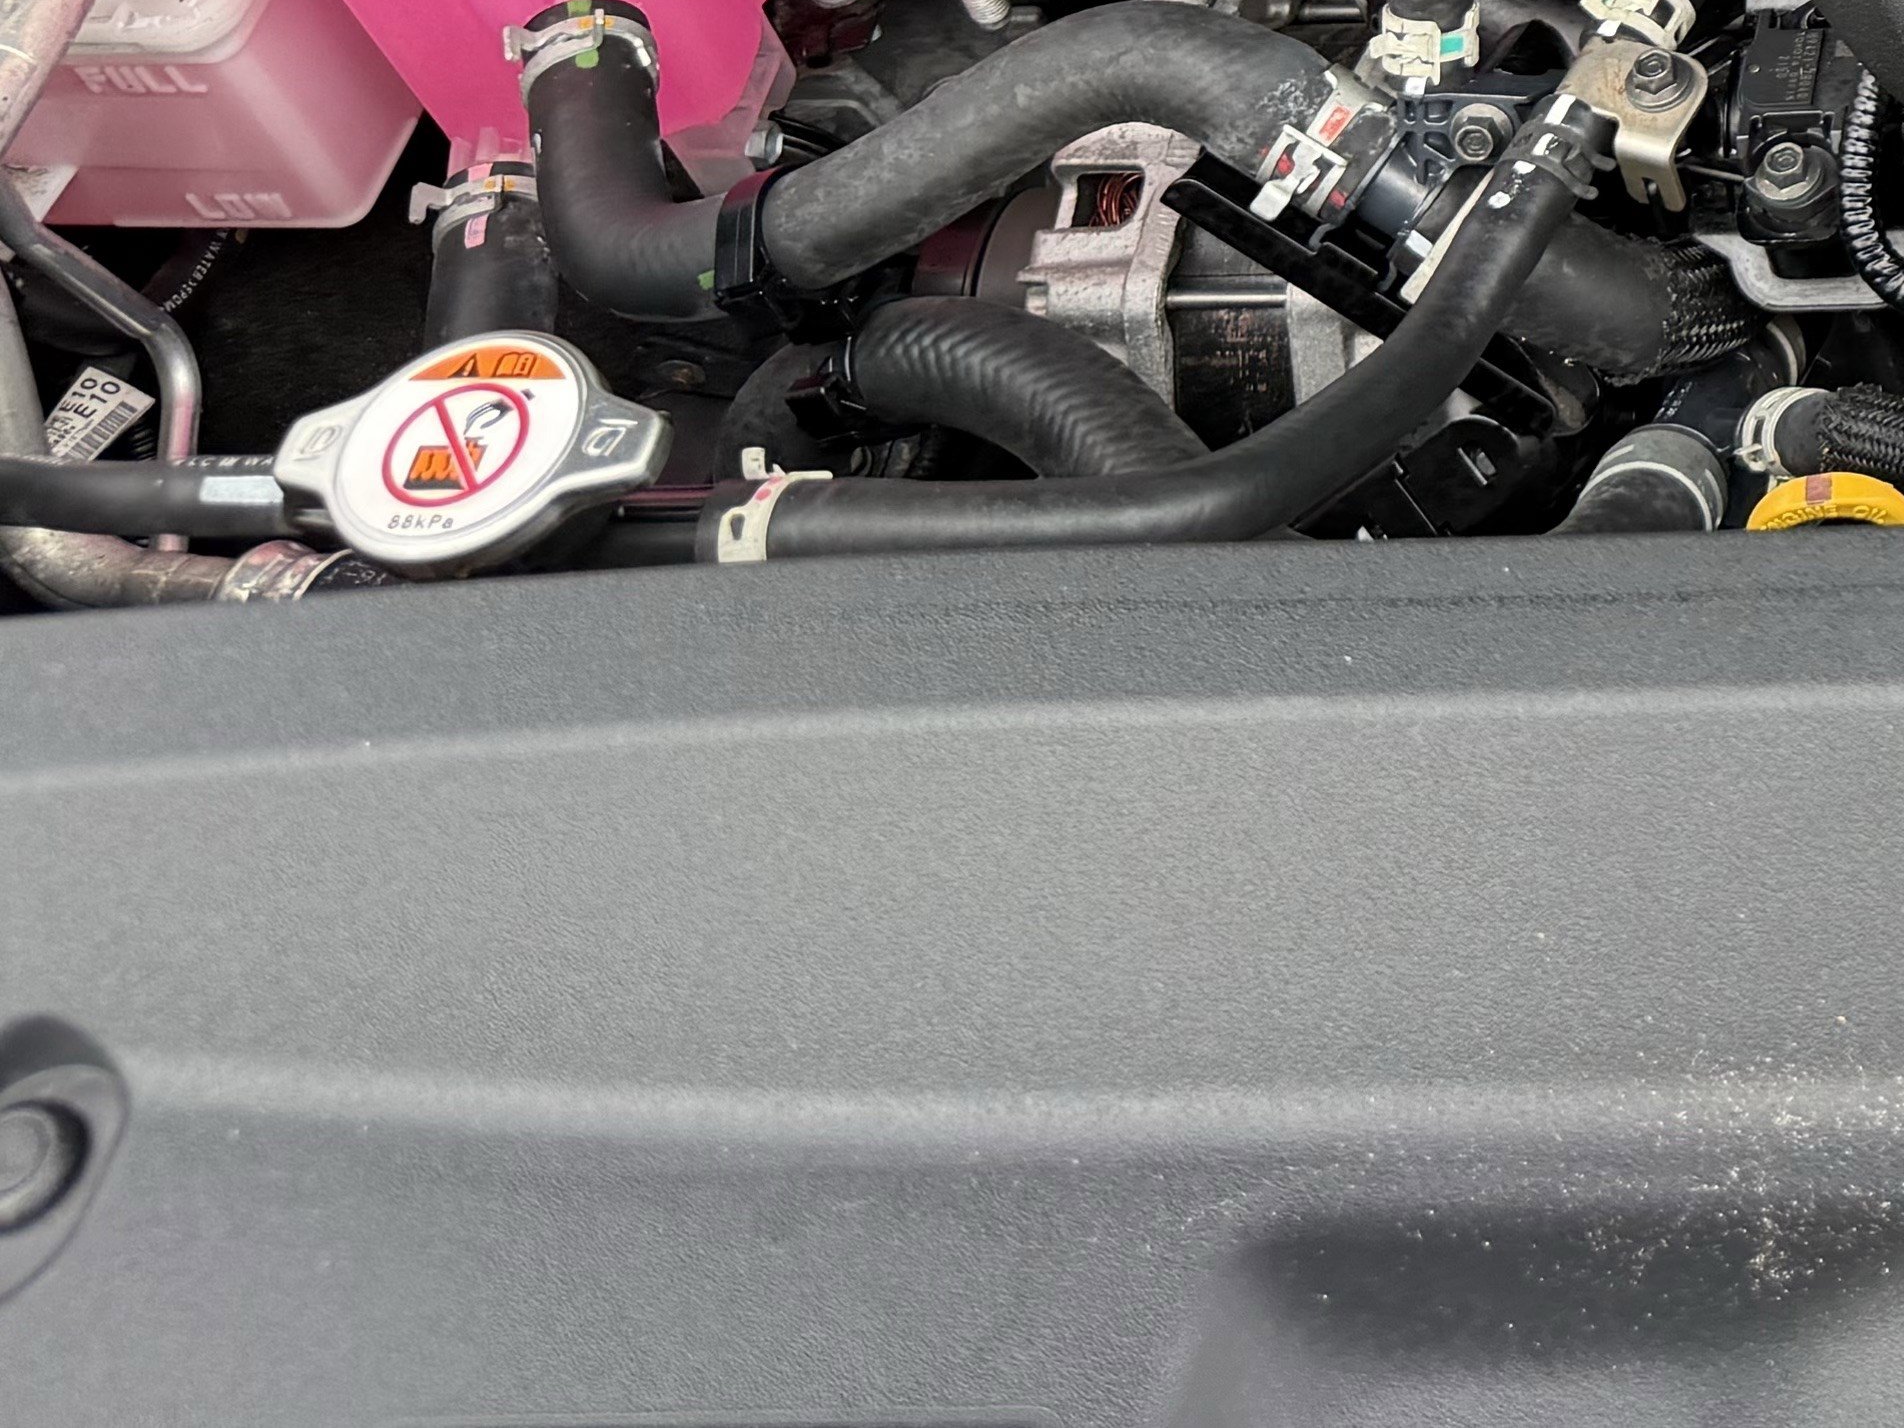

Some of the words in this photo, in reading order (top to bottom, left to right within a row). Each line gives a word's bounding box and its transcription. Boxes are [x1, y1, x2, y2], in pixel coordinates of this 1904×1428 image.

[74, 65, 208, 94] FULL
[185, 192, 292, 220] LOW
[59, 376, 98, 412] E10
[75, 381, 121, 418] E10
[387, 513, 454, 531] 88kPa
[1760, 505, 1838, 532] NGINE
[1852, 505, 1888, 525] OIL
